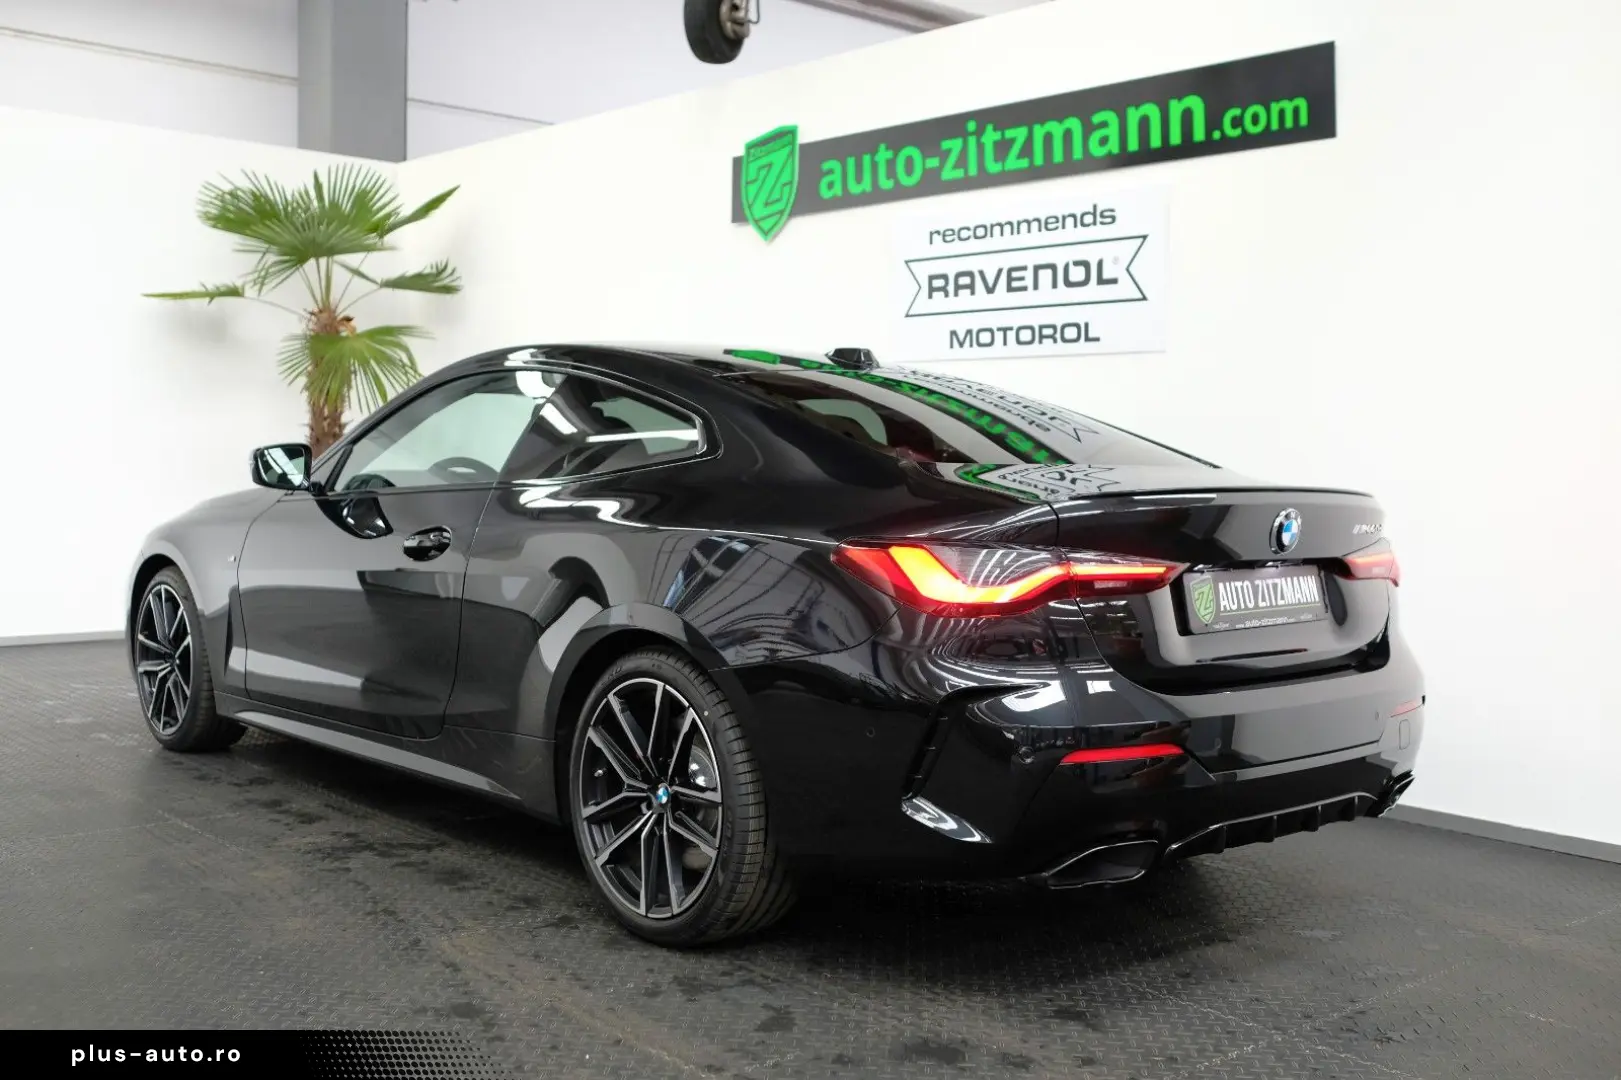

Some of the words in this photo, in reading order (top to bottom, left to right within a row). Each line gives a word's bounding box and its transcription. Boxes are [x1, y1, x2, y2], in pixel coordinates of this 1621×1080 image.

[819, 94, 1309, 199] auto-zitzmann.com
[929, 204, 1117, 245] recommends
[927, 258, 1119, 300] RAVENOL
[949, 322, 1101, 349] MOTOROL
[1218, 580, 1254, 611] AUTO
[1254, 575, 1319, 607] ZITZMANN
